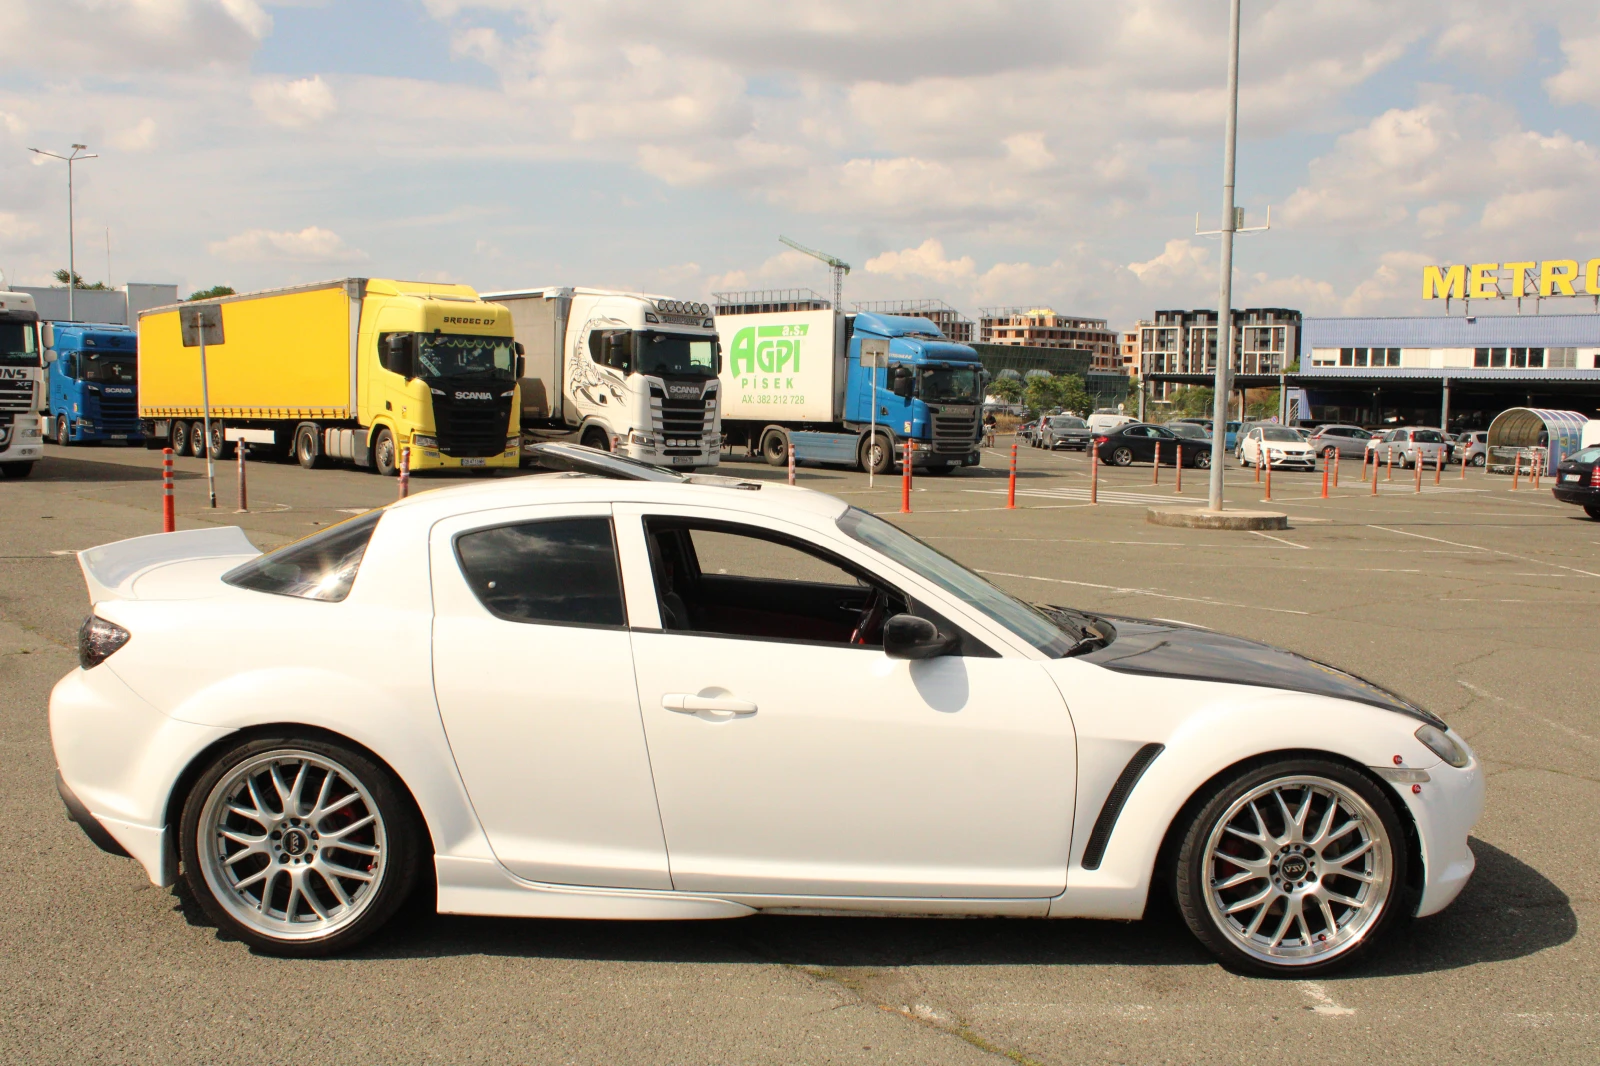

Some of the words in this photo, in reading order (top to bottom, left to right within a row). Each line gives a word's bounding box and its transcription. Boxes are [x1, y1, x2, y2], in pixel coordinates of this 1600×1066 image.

[443, 316, 481, 325] SREDEC
[729, 326, 801, 380] AGPI
[741, 375, 794, 389] PÍSEK
[669, 385, 701, 394] SCANIA
[454, 391, 492, 400] SCANIA
[756, 394, 771, 404] 382
[773, 395, 788, 405] 212
[790, 395, 805, 405] 728
